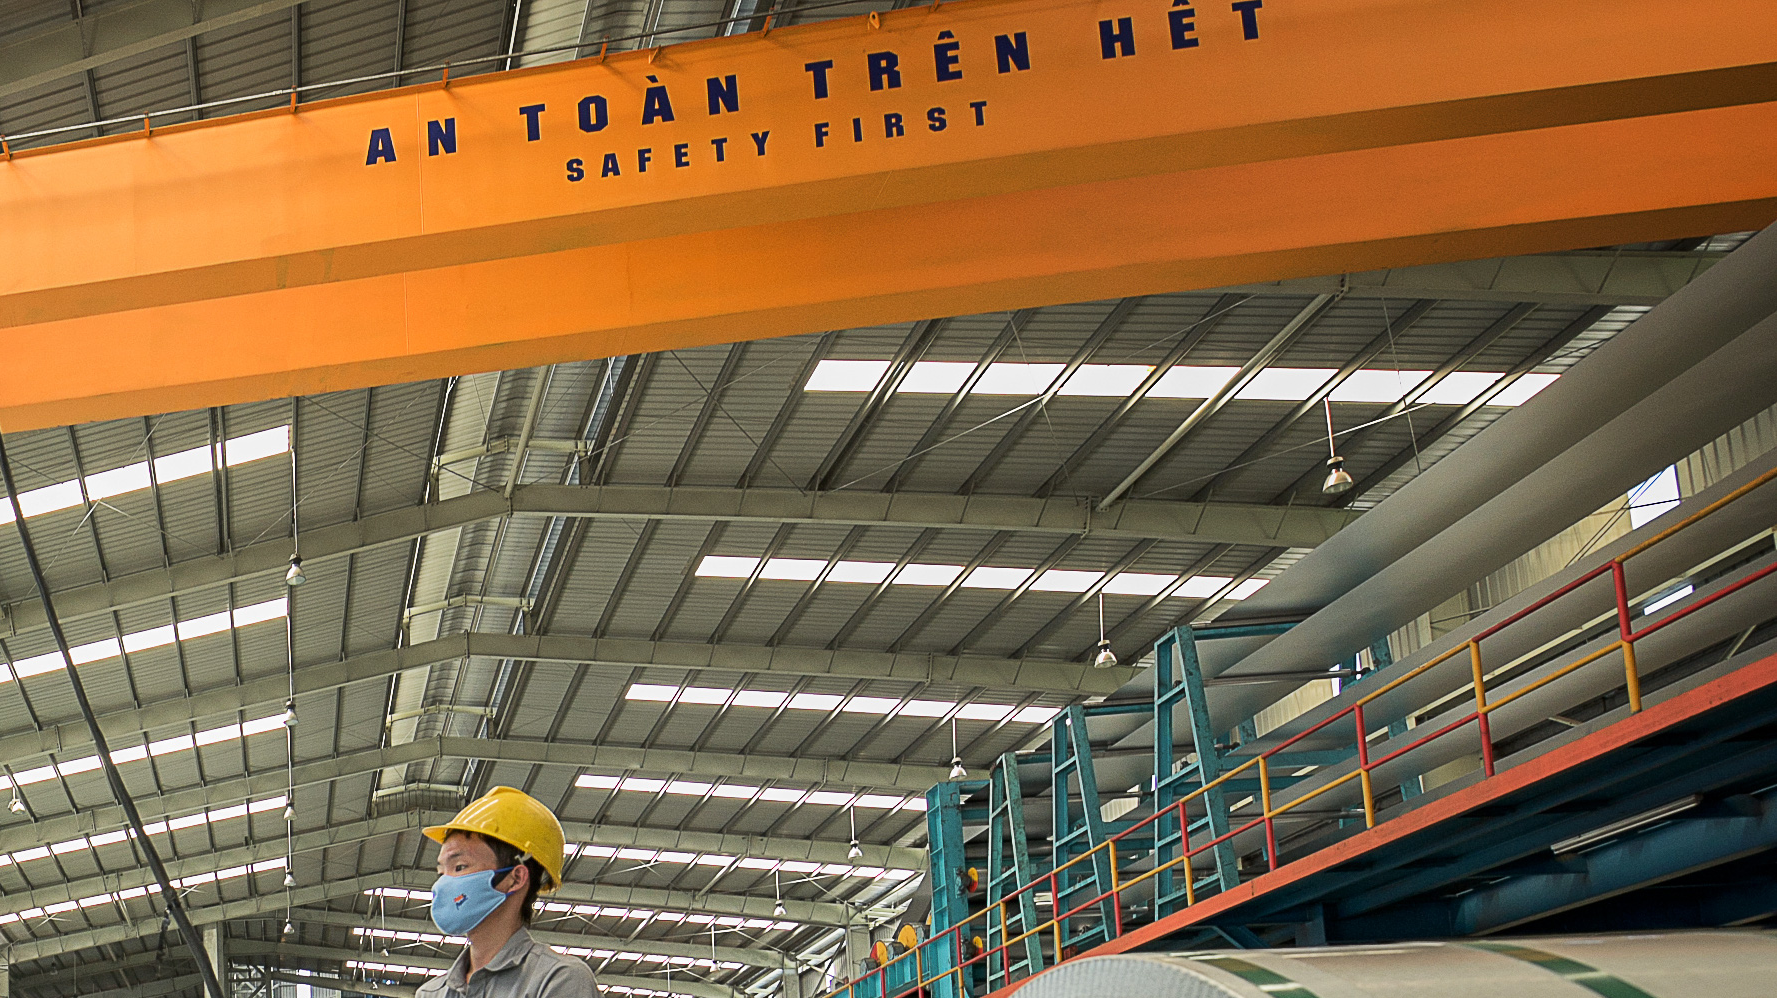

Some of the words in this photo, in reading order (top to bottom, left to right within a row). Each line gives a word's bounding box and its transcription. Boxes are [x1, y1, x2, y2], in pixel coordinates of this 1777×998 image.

[365, 118, 457, 166] AN
[519, 74, 740, 142] TOÀN
[804, 30, 1031, 100] TRÊN
[566, 131, 770, 182] SAFETY
[814, 100, 988, 148] FIRST
